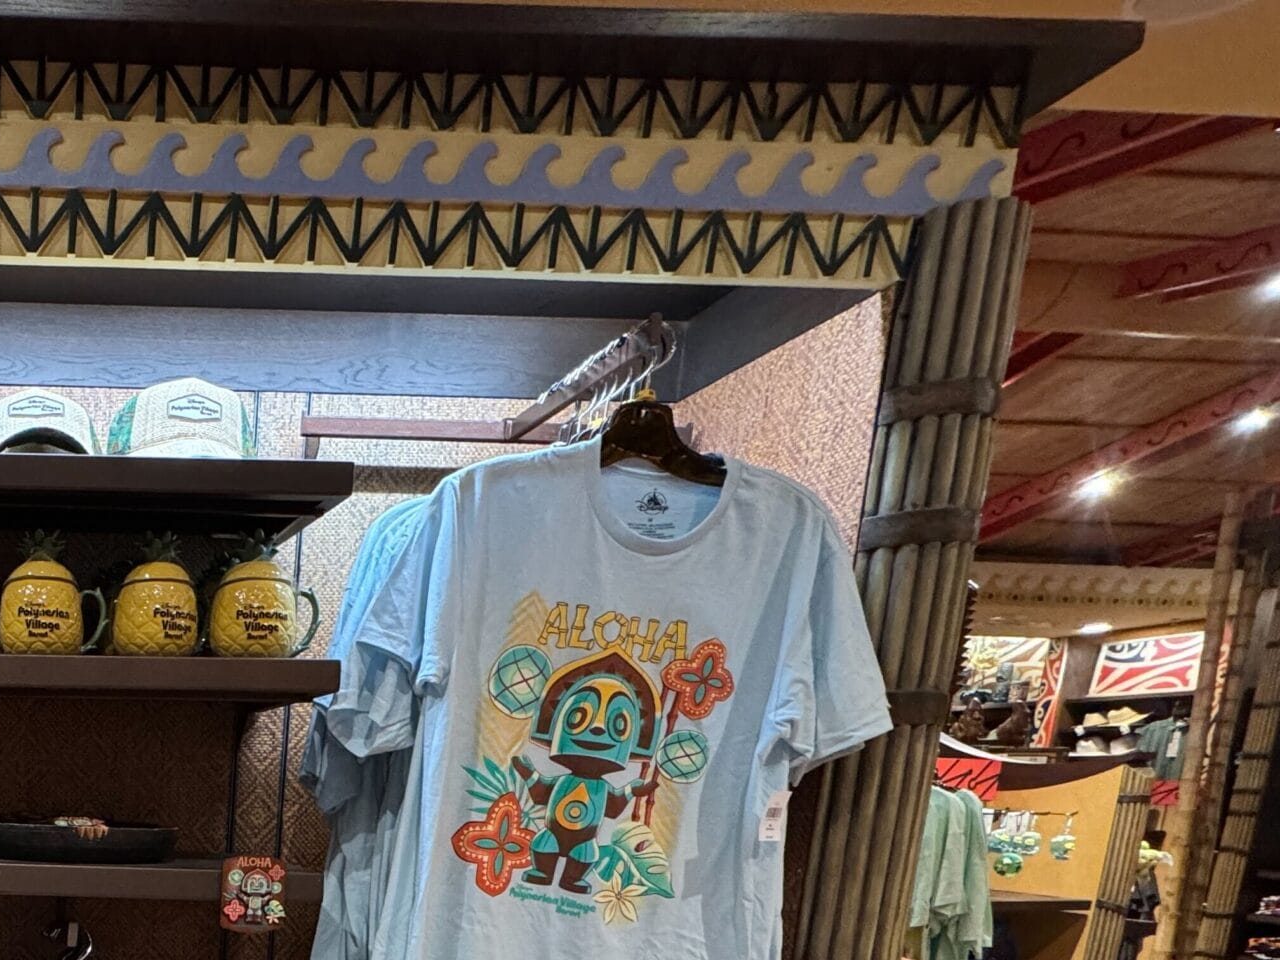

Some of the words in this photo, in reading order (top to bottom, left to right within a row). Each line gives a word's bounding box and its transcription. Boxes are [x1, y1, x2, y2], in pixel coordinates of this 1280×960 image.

[17, 606, 70, 619] Polynesian
[236, 609, 288, 621] Polynesian
[25, 618, 60, 632] Village
[162, 619, 192, 635] Village
[244, 620, 280, 634] Village
[537, 601, 688, 663] ALOHA
[237, 856, 272, 868] ALOHA
